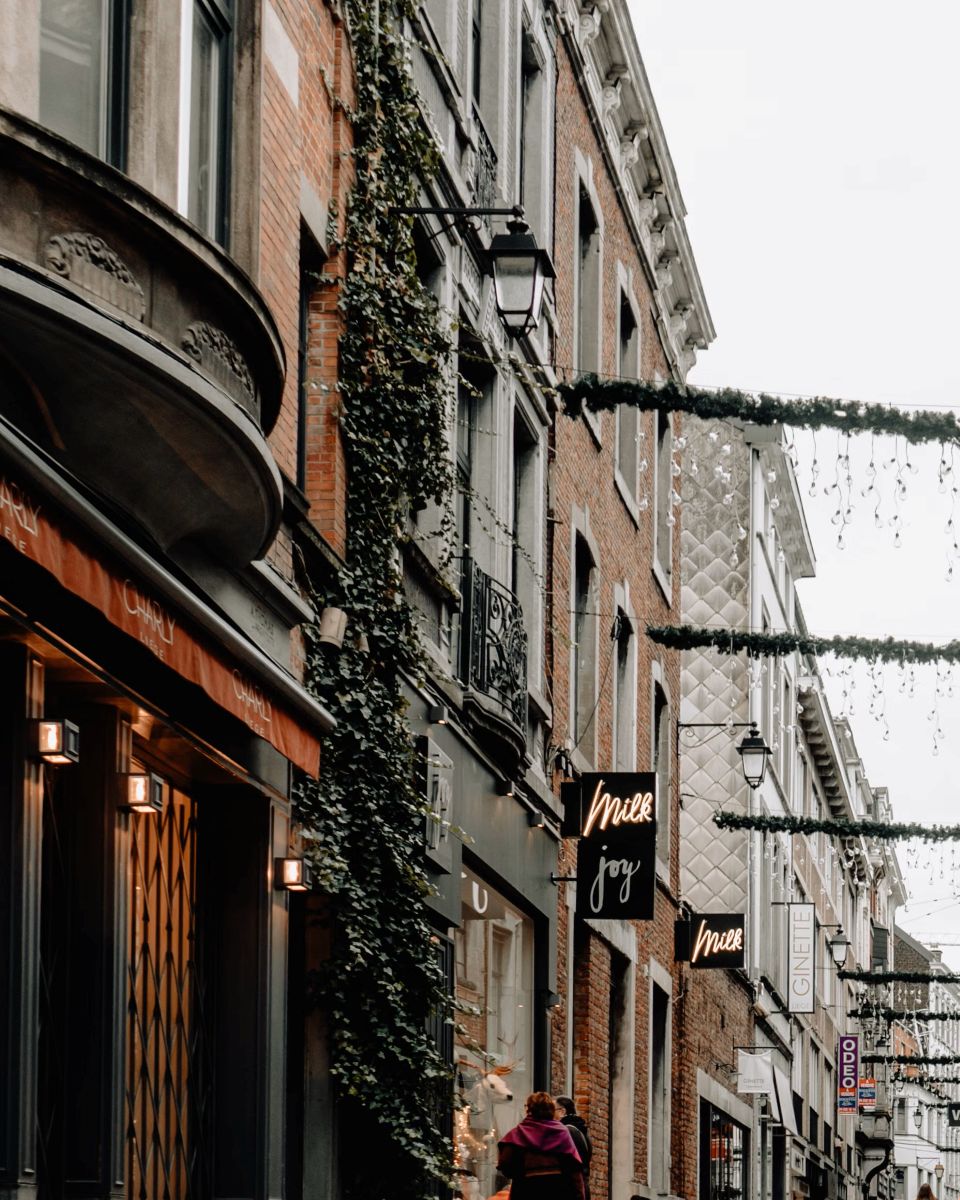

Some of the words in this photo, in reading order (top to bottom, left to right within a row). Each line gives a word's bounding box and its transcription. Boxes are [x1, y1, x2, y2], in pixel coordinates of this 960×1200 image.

[123, 578, 176, 646] CHARLY
[590, 845, 641, 913] joy
[792, 911, 811, 997] GINETTE
[842, 1039, 856, 1089] ODEO
